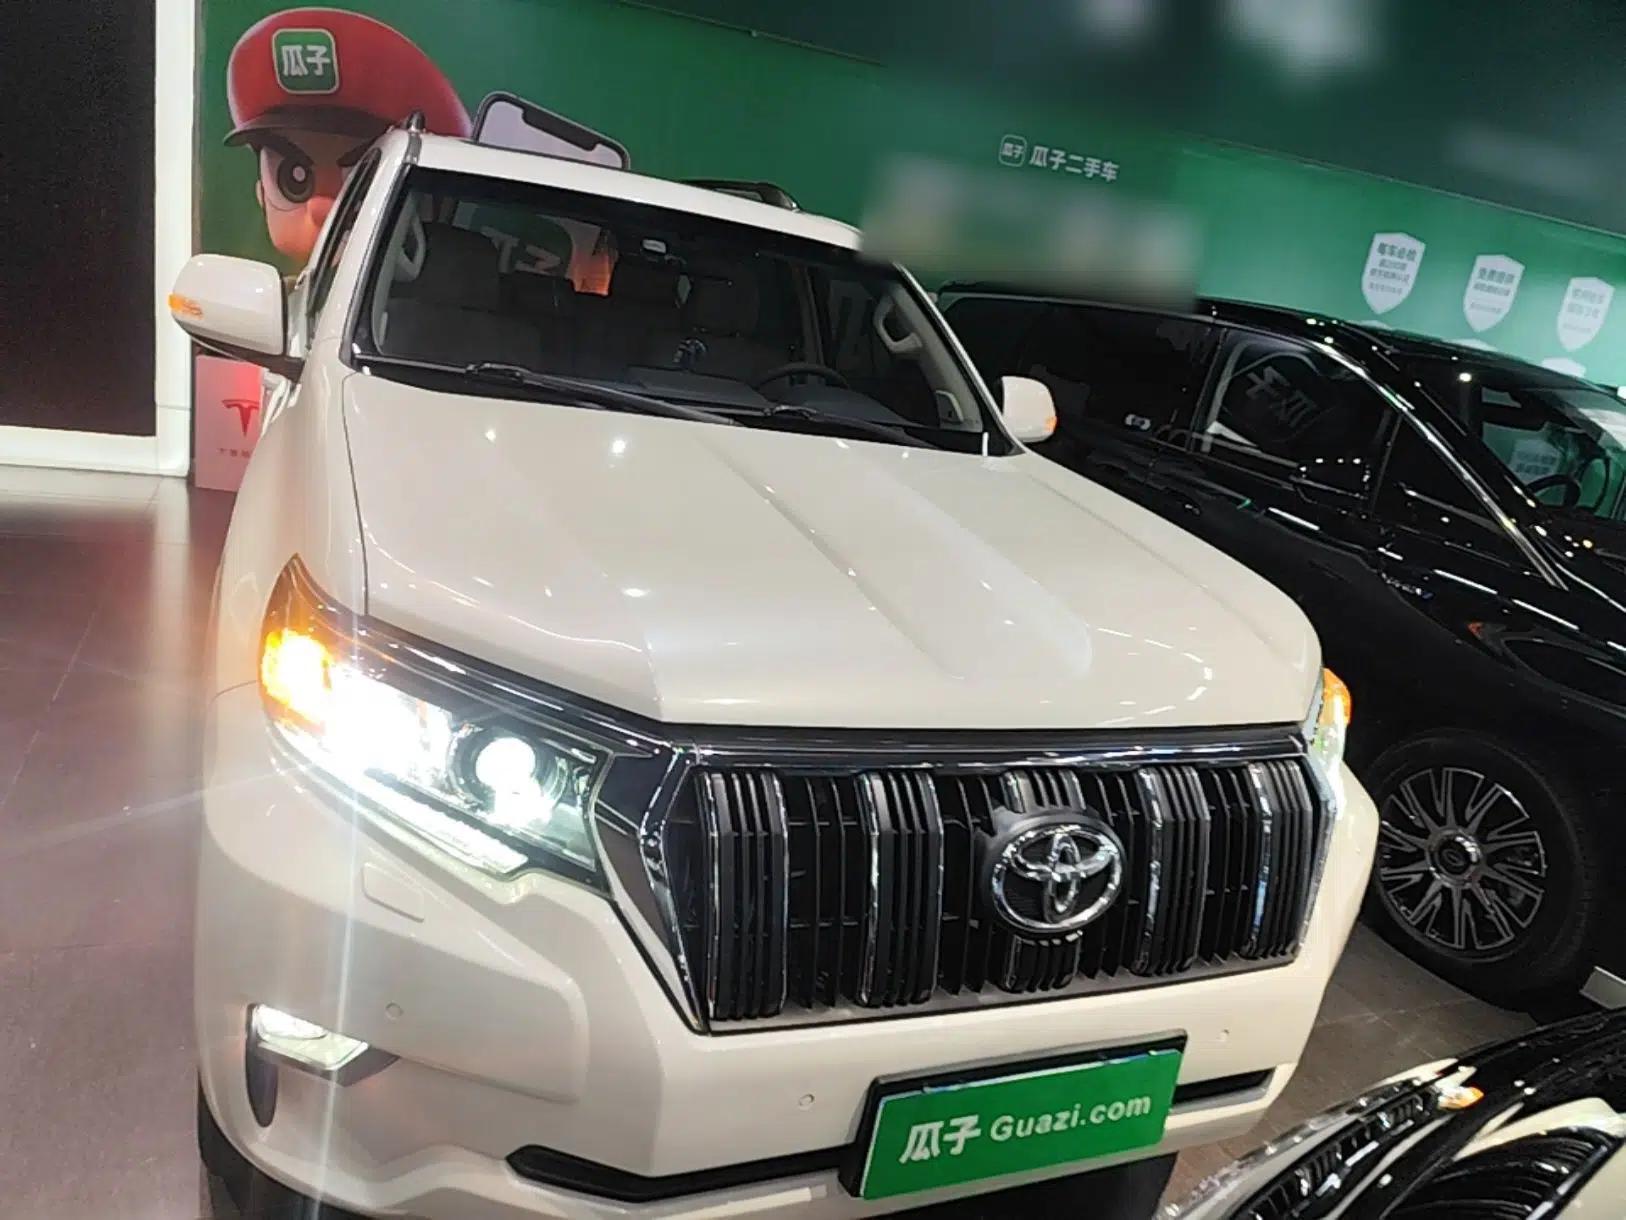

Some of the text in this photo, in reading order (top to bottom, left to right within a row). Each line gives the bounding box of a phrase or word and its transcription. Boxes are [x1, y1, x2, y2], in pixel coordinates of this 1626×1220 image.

[282, 45, 330, 76] 瓜子
[1029, 146, 1119, 181] 瓜子二手车
[899, 1096, 1150, 1164] 瓜子 Guazi.com
